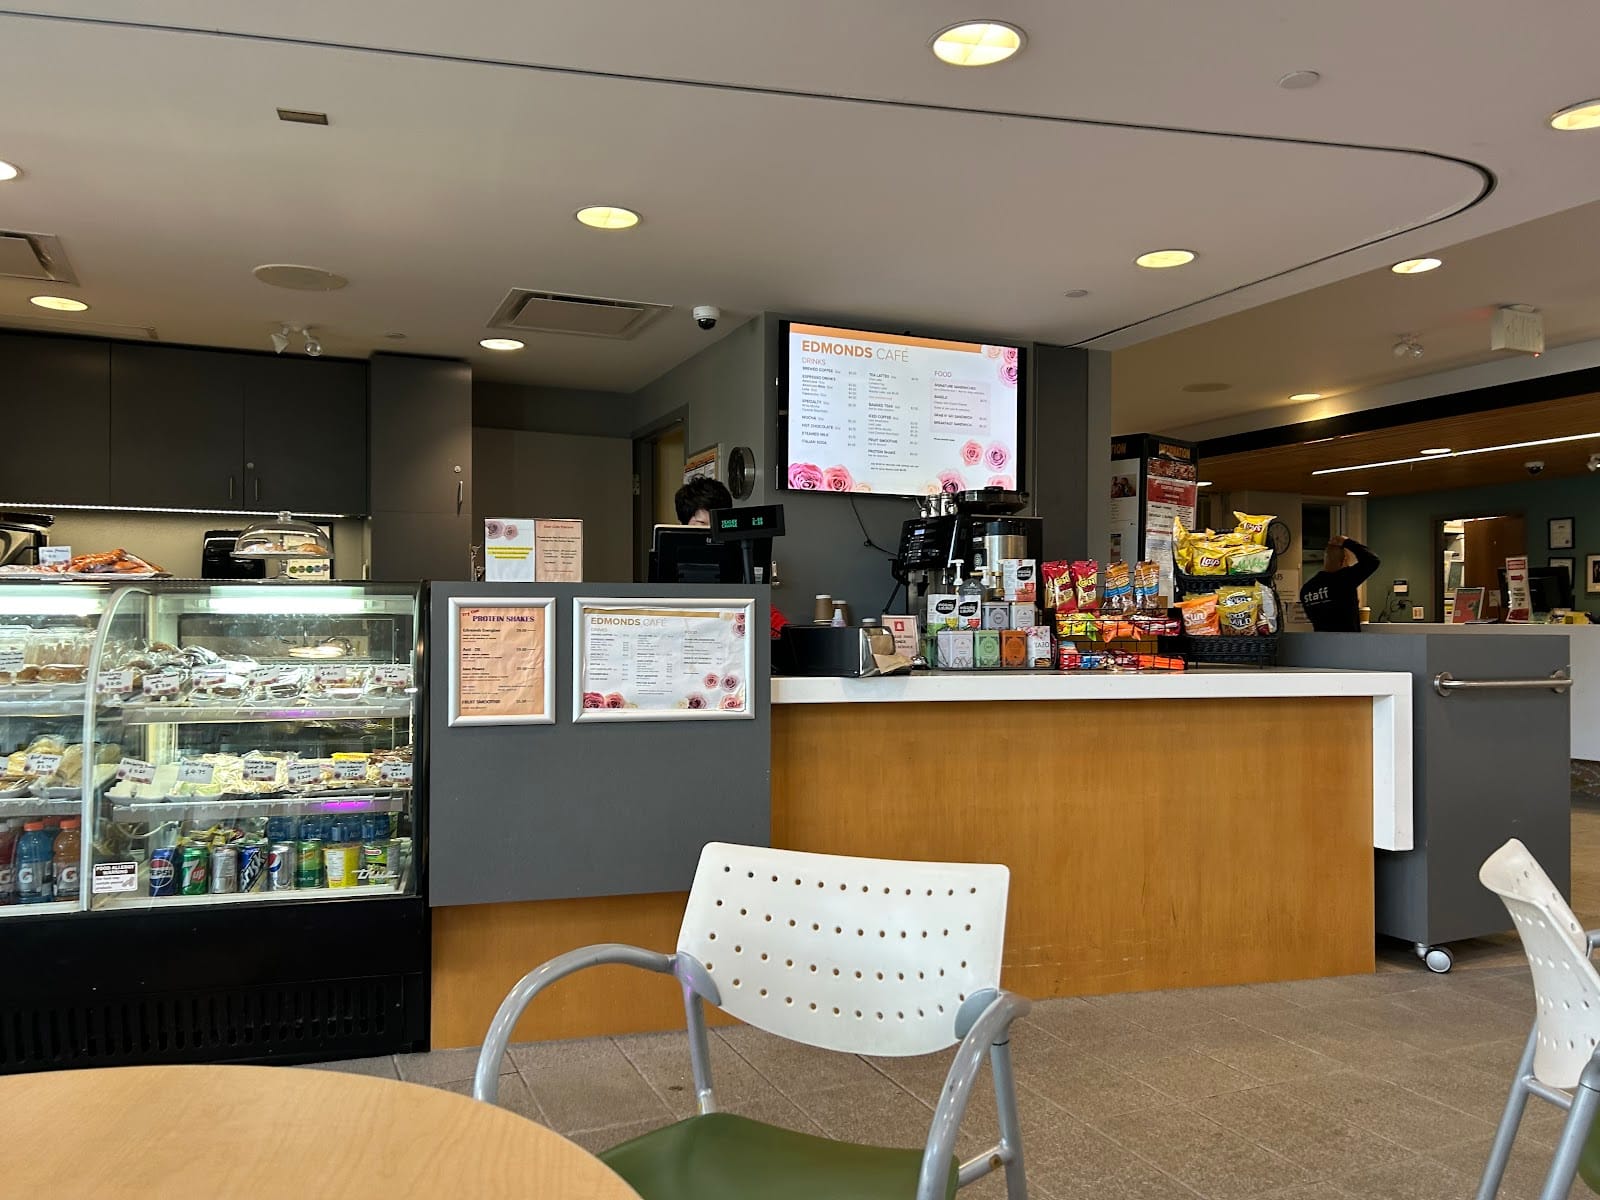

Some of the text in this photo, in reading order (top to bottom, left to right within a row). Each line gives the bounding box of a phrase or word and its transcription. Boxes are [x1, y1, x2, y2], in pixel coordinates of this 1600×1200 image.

[802, 340, 873, 358] EDMONDS
[802, 357, 826, 366] DRINKS
[934, 370, 952, 378] FOOD
[1304, 587, 1329, 603] staff
[591, 617, 641, 626] EDMONDS
[19, 867, 33, 884] G
[61, 867, 77, 883] G
